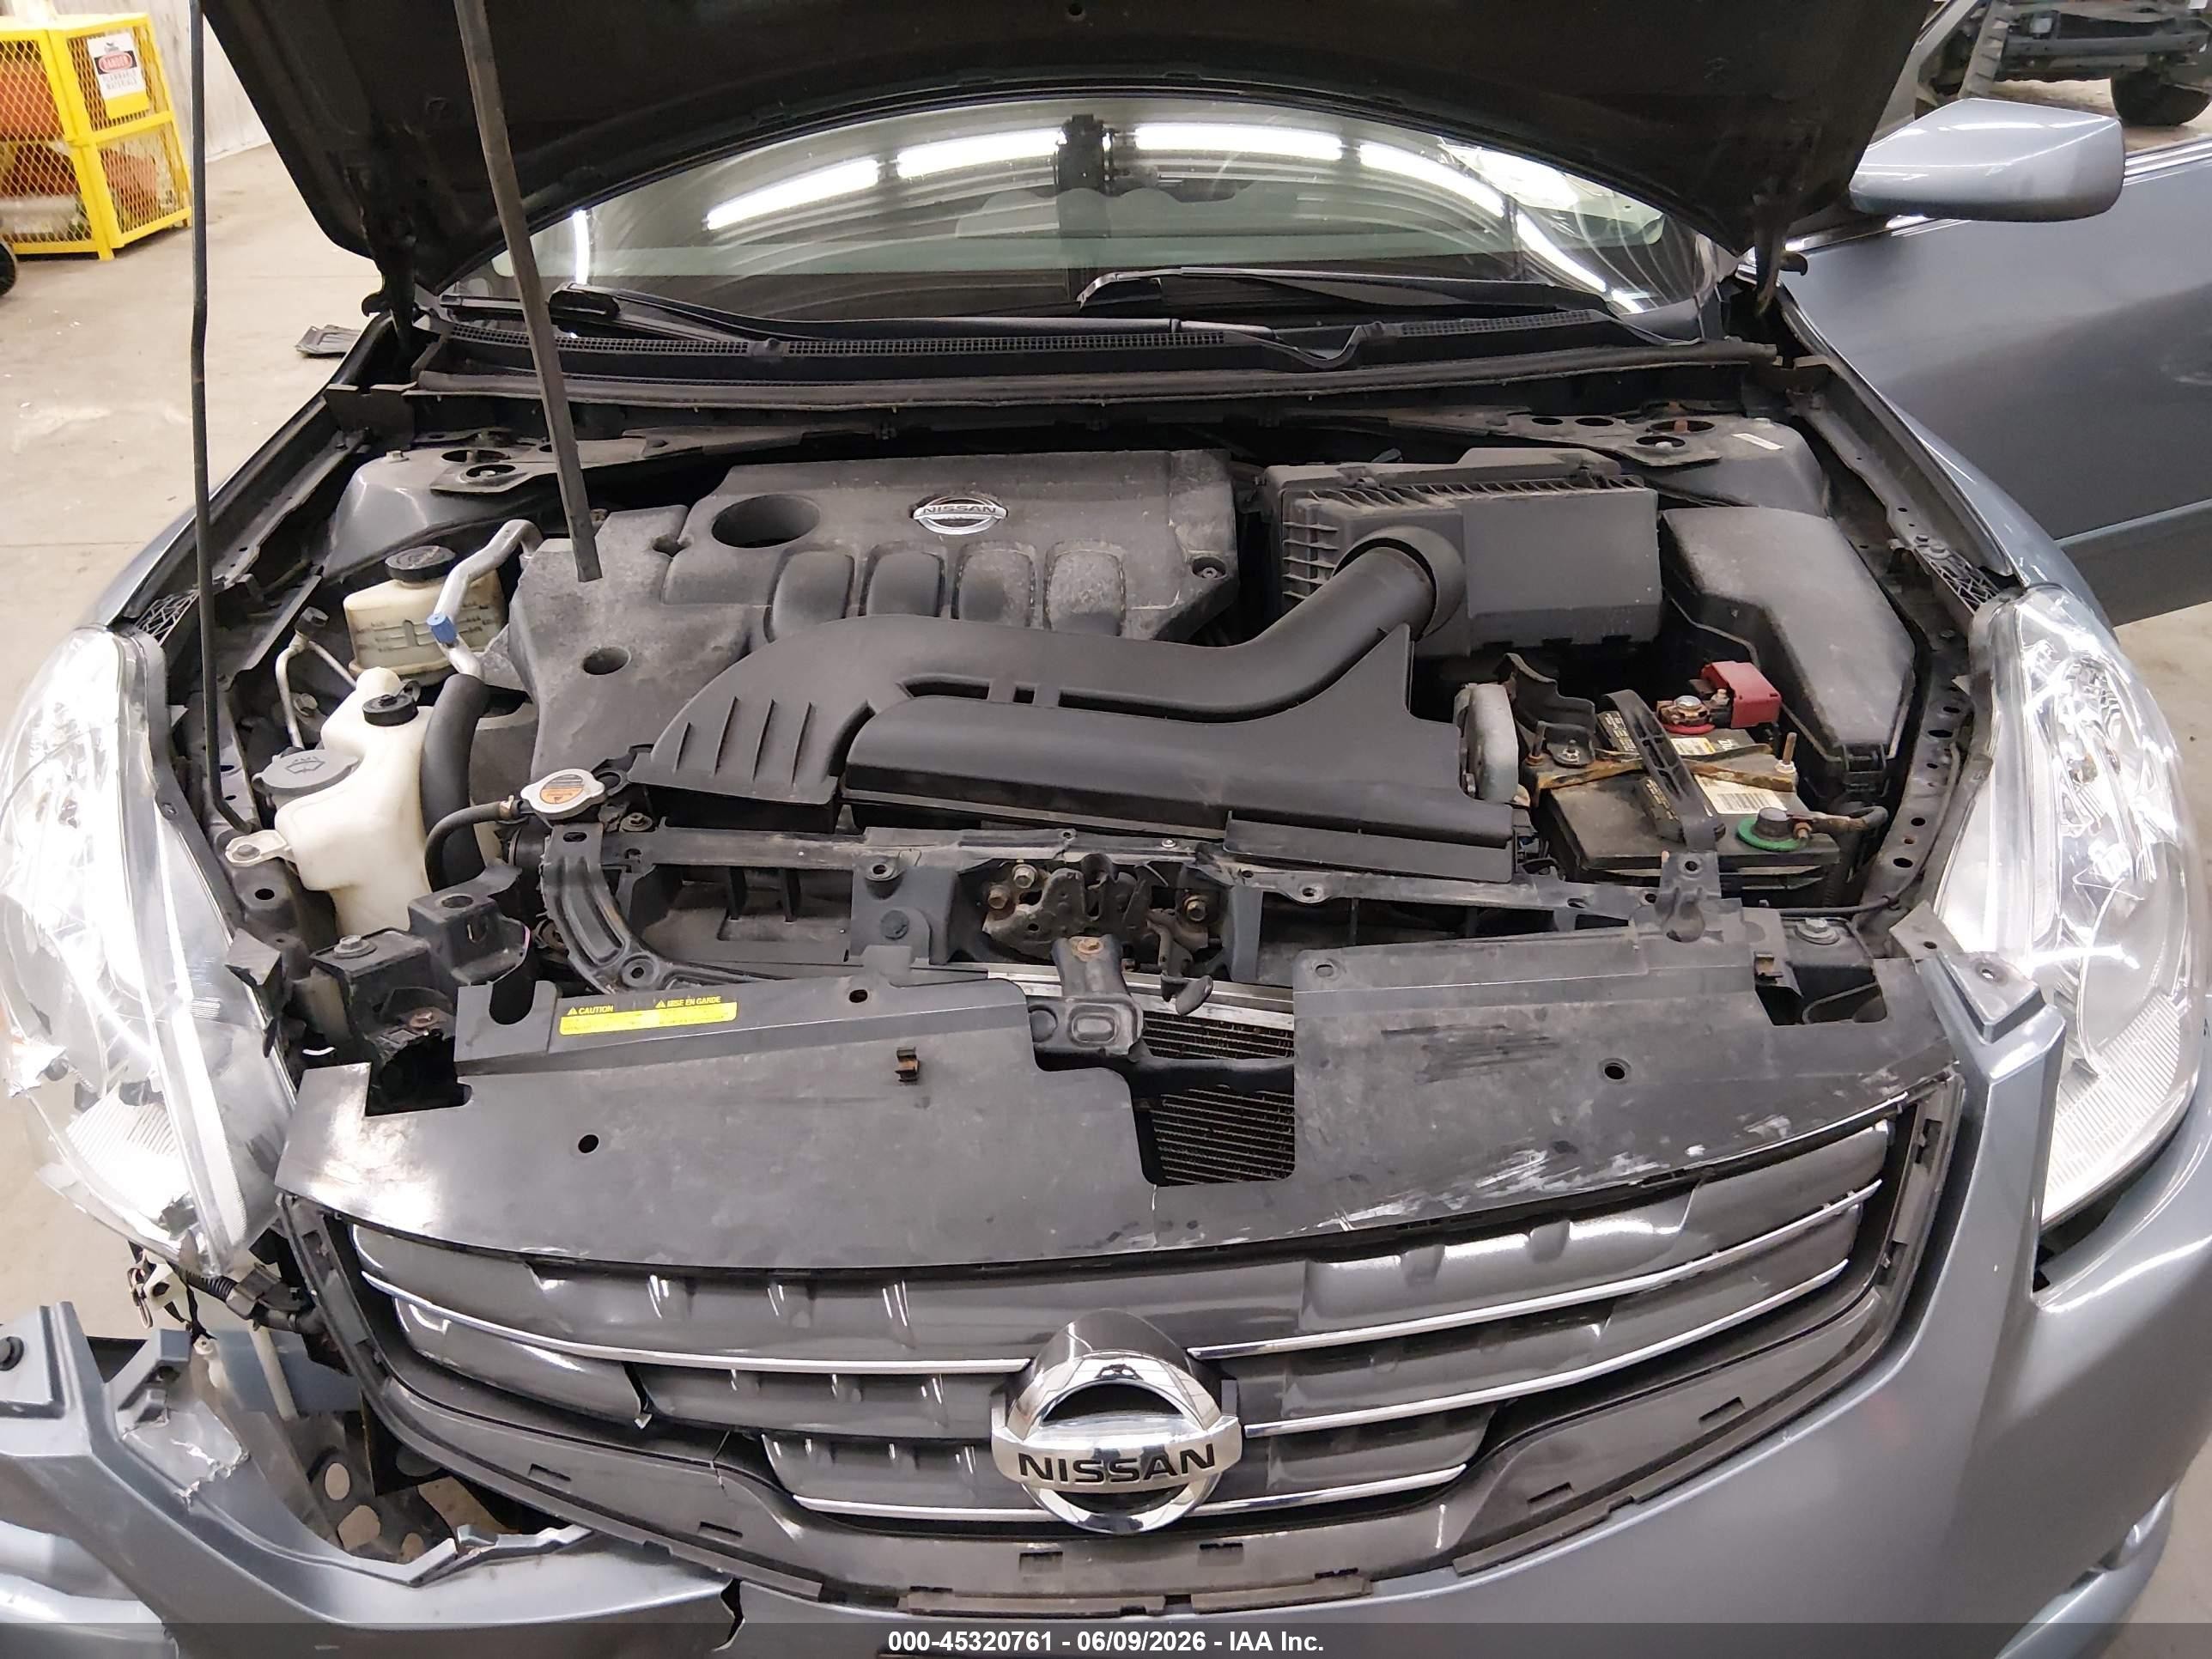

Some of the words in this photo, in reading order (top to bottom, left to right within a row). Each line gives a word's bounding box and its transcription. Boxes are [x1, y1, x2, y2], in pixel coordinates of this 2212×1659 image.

[923, 505, 997, 514] NISSAN
[696, 995, 721, 1005] GARDE
[578, 1005, 614, 1015] CAUTION
[1018, 1443, 1215, 1483] NISSAN
